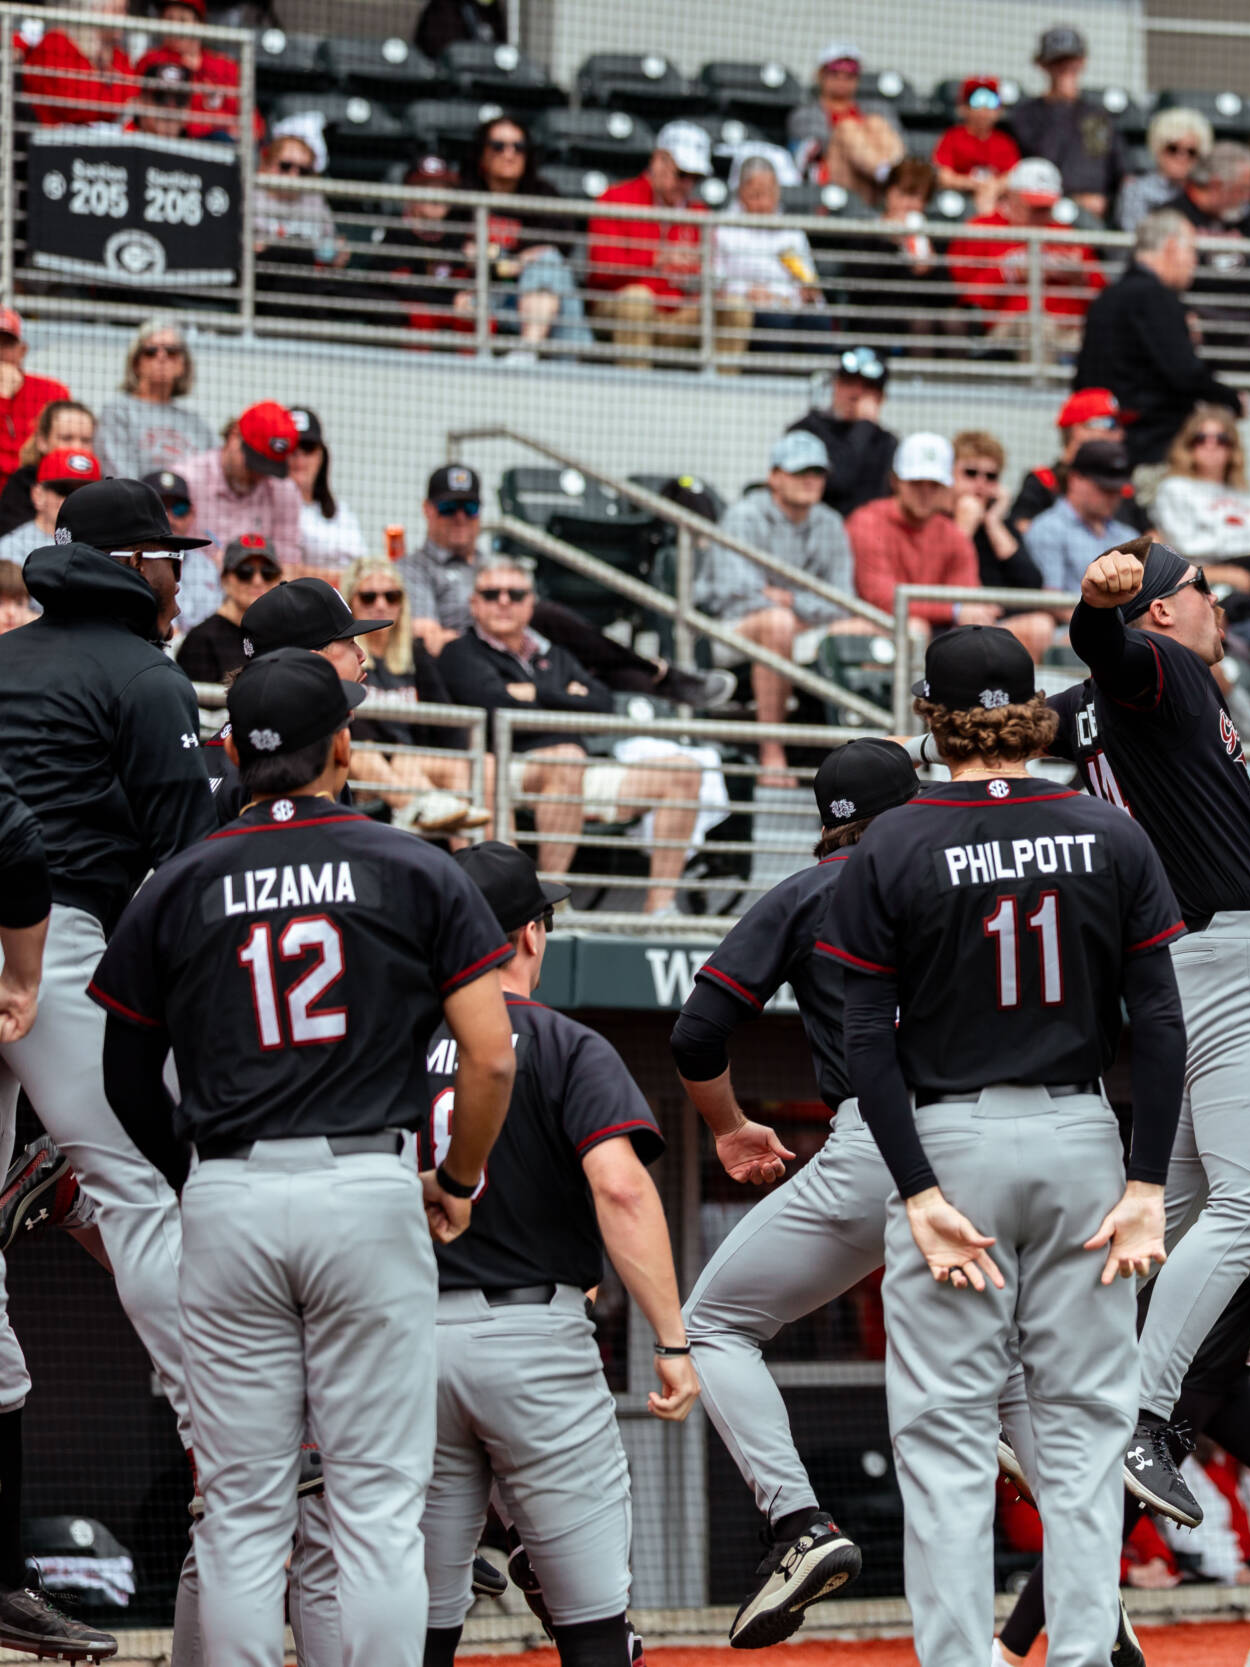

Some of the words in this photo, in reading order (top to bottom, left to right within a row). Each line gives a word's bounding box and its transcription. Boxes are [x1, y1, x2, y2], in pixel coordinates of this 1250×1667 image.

[69, 180, 129, 218] 205
[144, 188, 204, 226] 206
[945, 834, 1096, 886] PHILPOTT
[223, 861, 356, 917] LIZAMA
[982, 889, 1065, 1010] 11
[237, 913, 346, 1051] 12
